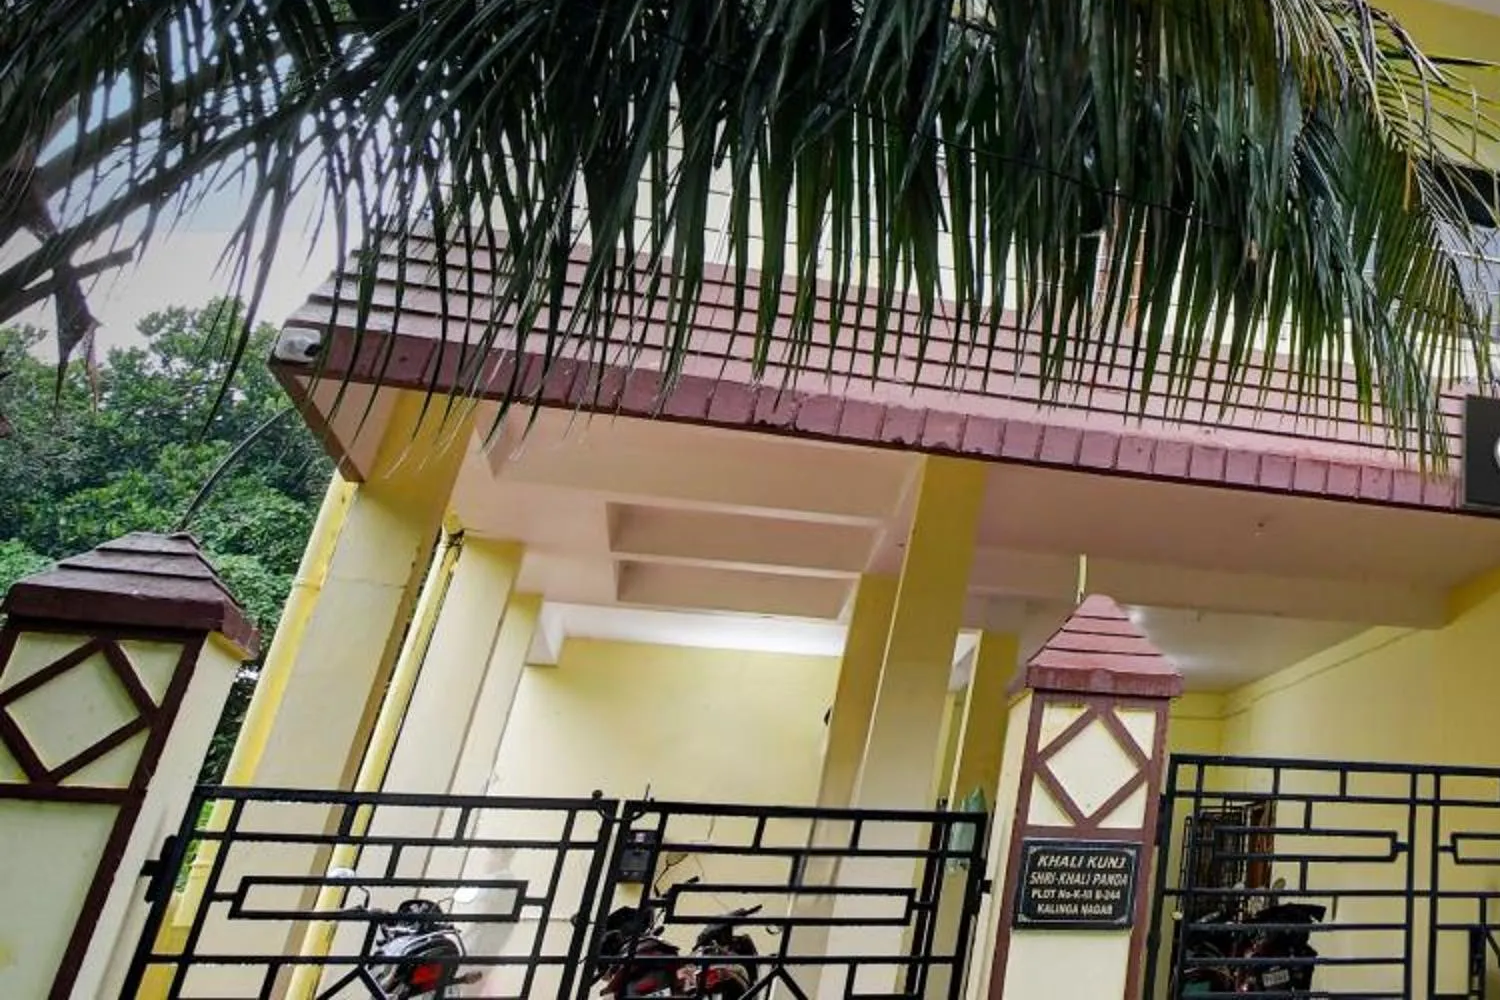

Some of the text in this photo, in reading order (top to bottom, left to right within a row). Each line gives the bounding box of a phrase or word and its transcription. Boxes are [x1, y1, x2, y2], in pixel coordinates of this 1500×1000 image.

[1037, 855, 1126, 869] KHALI KUNJ
[1031, 889, 1056, 899] PLOT
[1036, 903, 1079, 915] KALINGA
